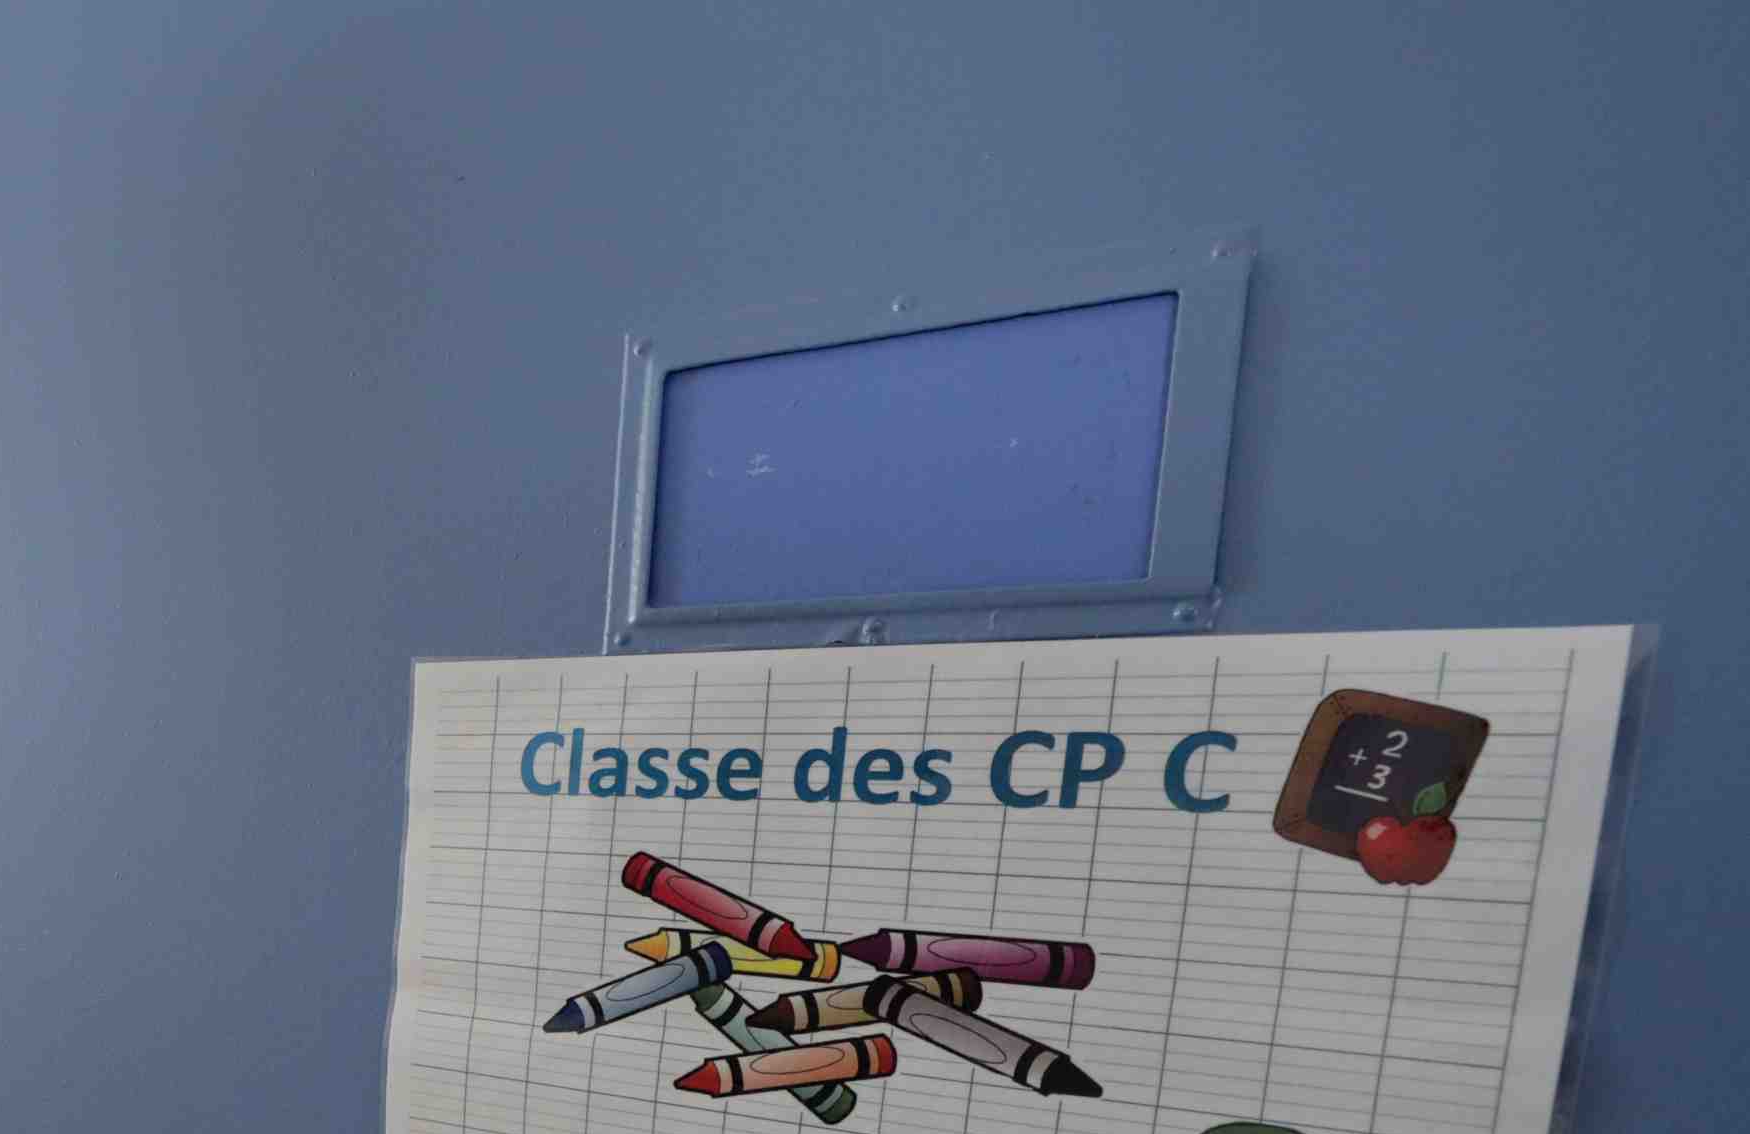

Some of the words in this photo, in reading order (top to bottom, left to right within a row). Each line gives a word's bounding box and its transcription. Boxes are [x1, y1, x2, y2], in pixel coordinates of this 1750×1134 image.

[1381, 729, 1409, 759] 2
[520, 727, 764, 801] Classe
[793, 726, 954, 806] des
[989, 730, 1126, 809] CP
[1163, 730, 1238, 813] C
[1367, 764, 1391, 789] 3
